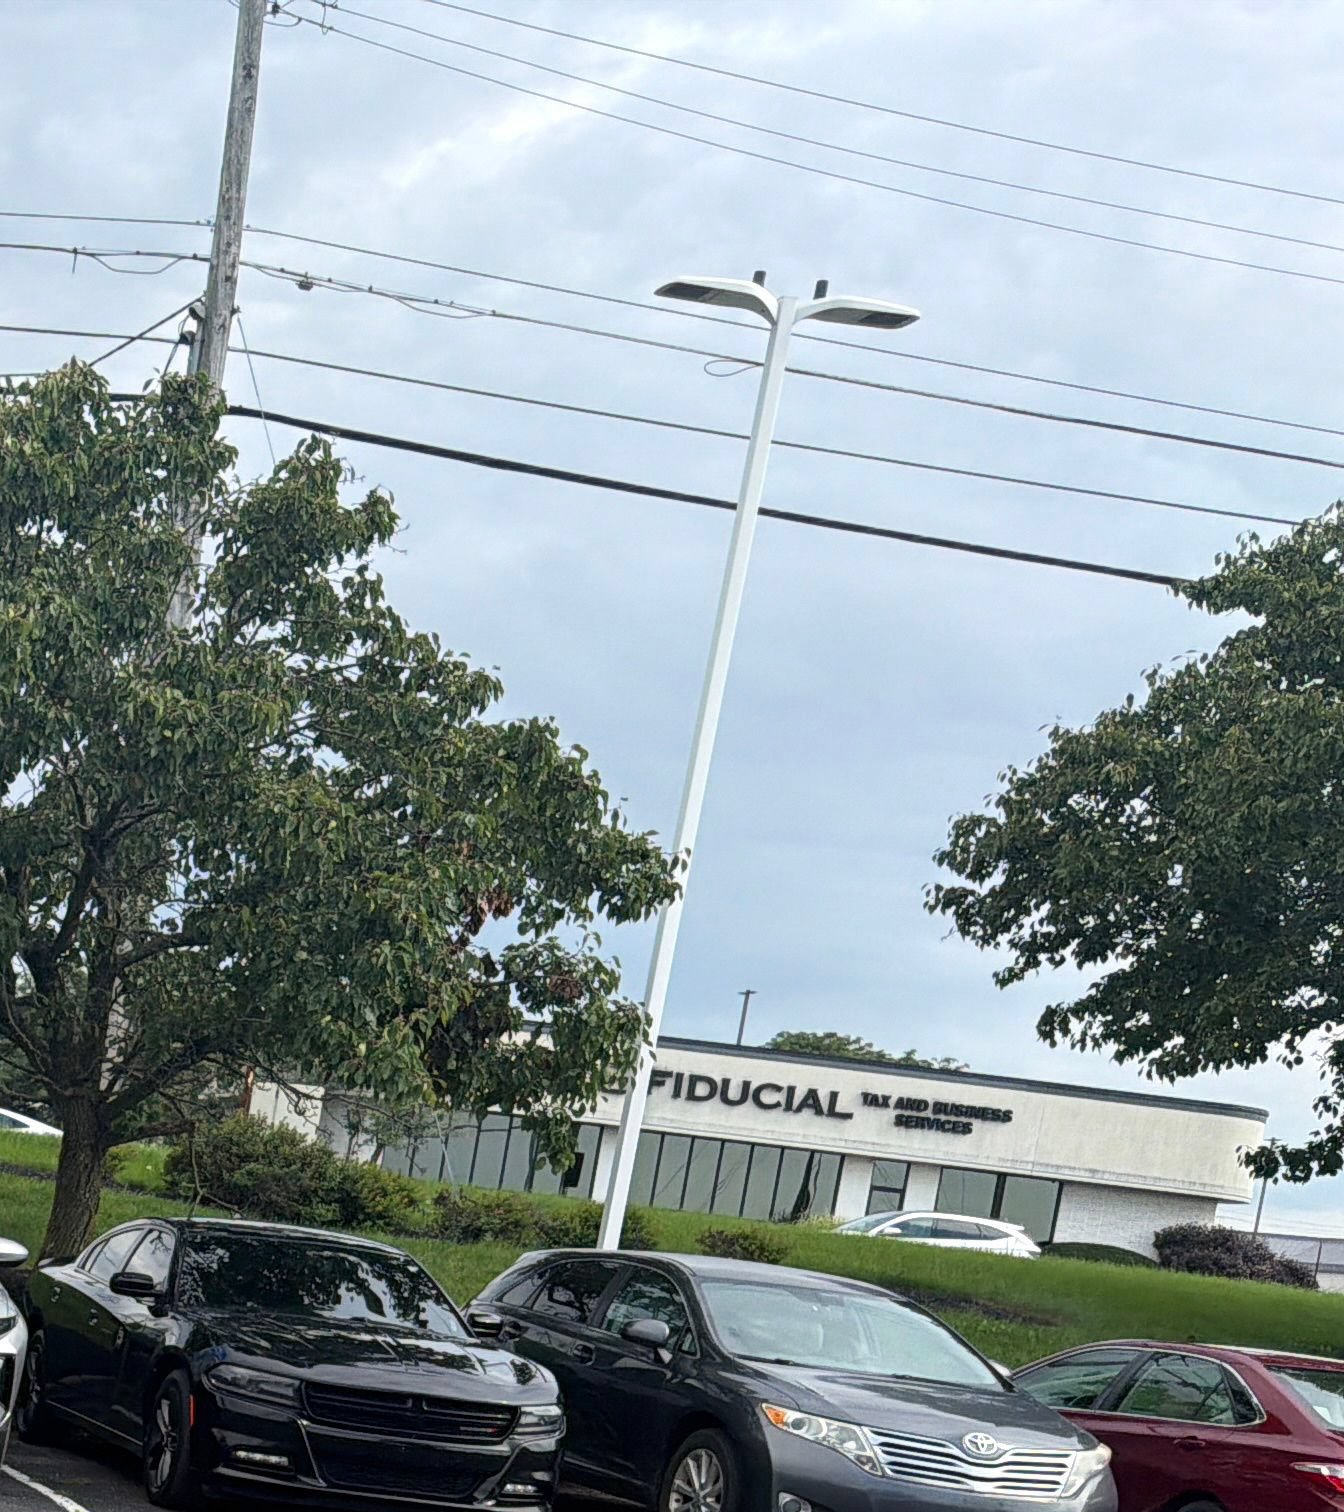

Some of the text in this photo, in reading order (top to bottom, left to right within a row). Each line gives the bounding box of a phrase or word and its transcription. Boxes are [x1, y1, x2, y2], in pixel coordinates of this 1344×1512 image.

[647, 1069, 854, 1119] FIDUCIAL
[861, 1091, 1013, 1123] TAX AND BUSINESS
[894, 1113, 974, 1135] SERVICES
